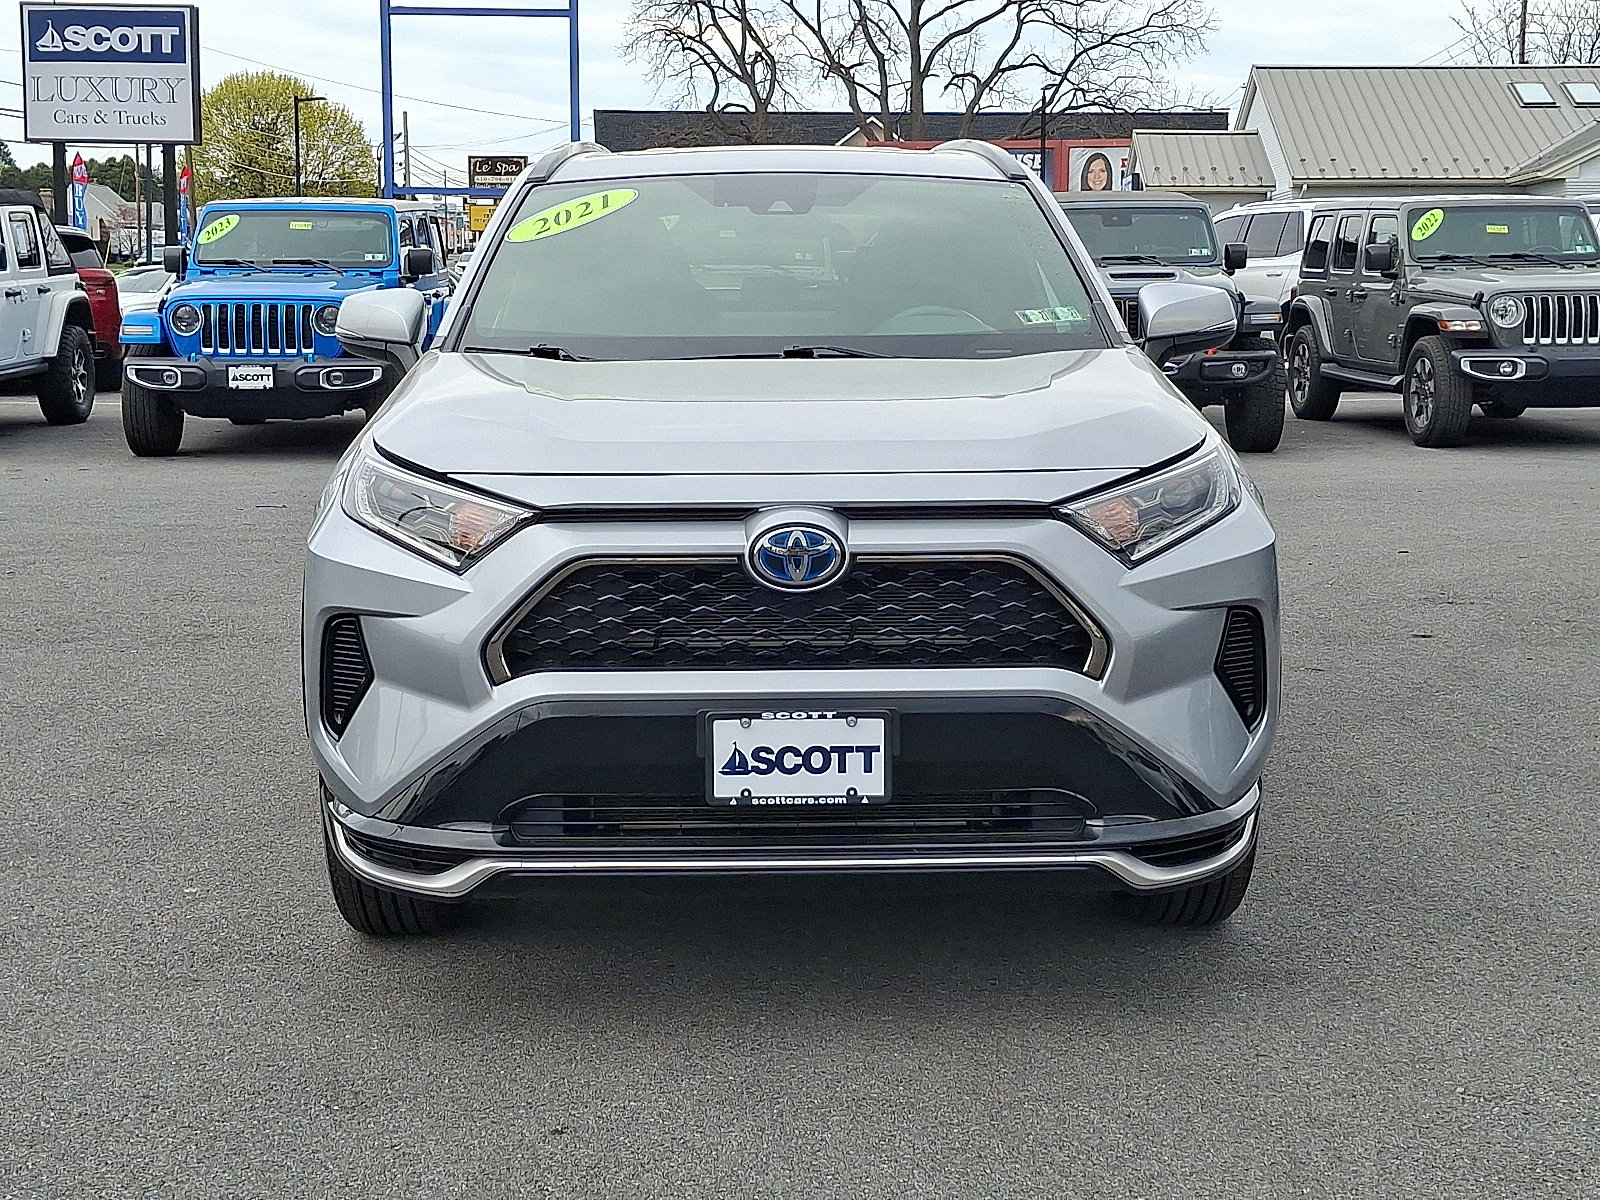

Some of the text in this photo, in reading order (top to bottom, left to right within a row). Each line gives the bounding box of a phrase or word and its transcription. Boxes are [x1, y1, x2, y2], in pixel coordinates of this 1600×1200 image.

[63, 25, 179, 53] SCOTT
[31, 76, 186, 104] LUXURY
[53, 109, 167, 126] Cars & Trucks
[495, 161, 520, 176] Spa
[74, 183, 84, 225] BUY
[533, 193, 610, 236] 2021
[205, 217, 231, 241] 2023
[1416, 212, 1439, 237] 2022
[238, 373, 272, 382] SCOTT
[761, 711, 837, 719] SCOTT
[751, 745, 881, 776] SCOTT
[751, 796, 847, 805] scottcars.com
